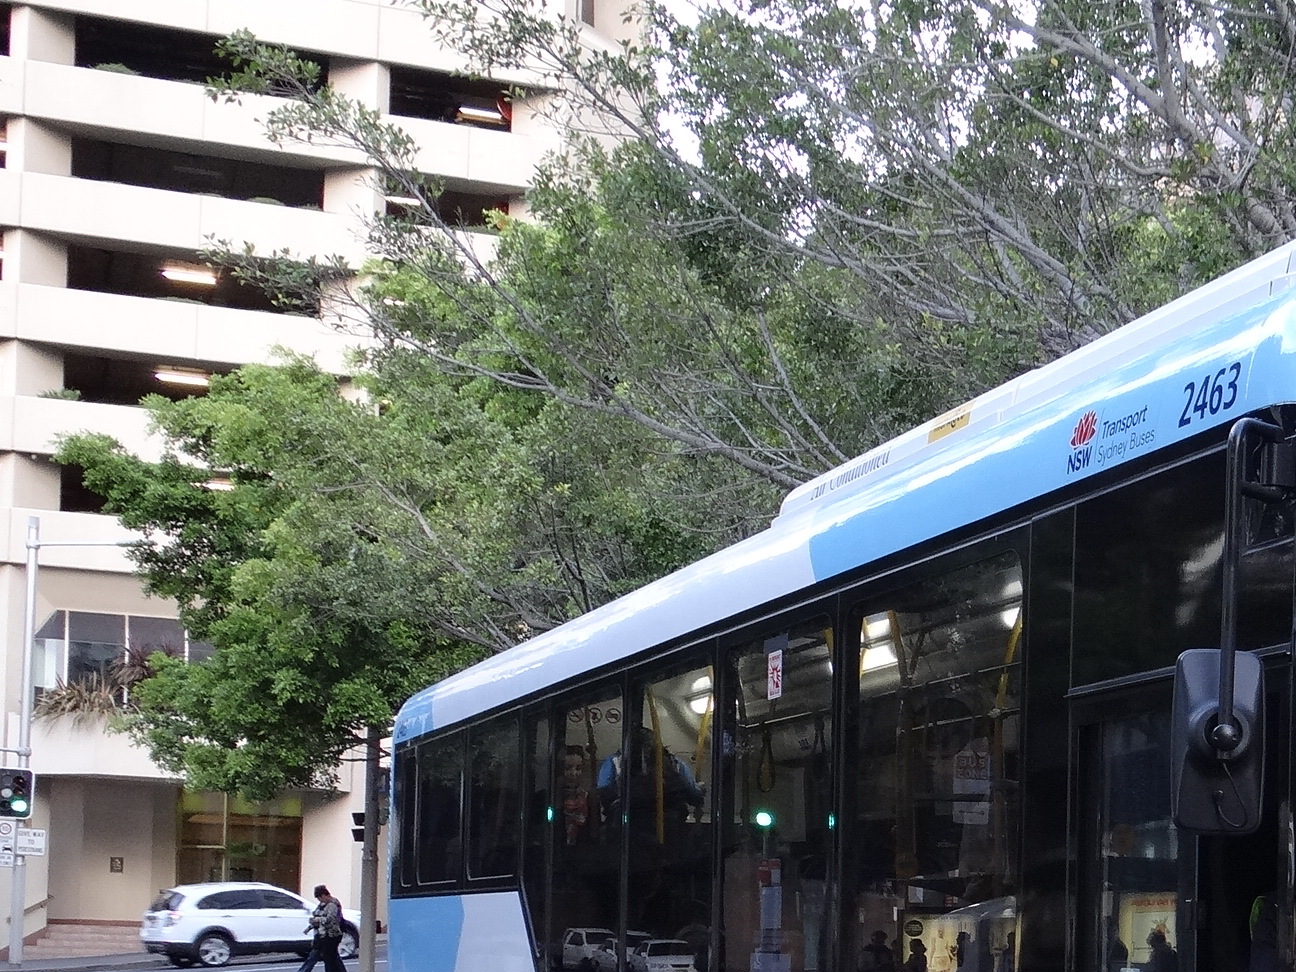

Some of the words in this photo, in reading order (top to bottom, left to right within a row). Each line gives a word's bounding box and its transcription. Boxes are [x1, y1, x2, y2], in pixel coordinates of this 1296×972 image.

[1178, 361, 1242, 428] 2463
[1101, 405, 1149, 440] Transport
[1066, 446, 1092, 475] NSW
[1097, 440, 1127, 467] Sydney
[1129, 429, 1155, 448] Buses
